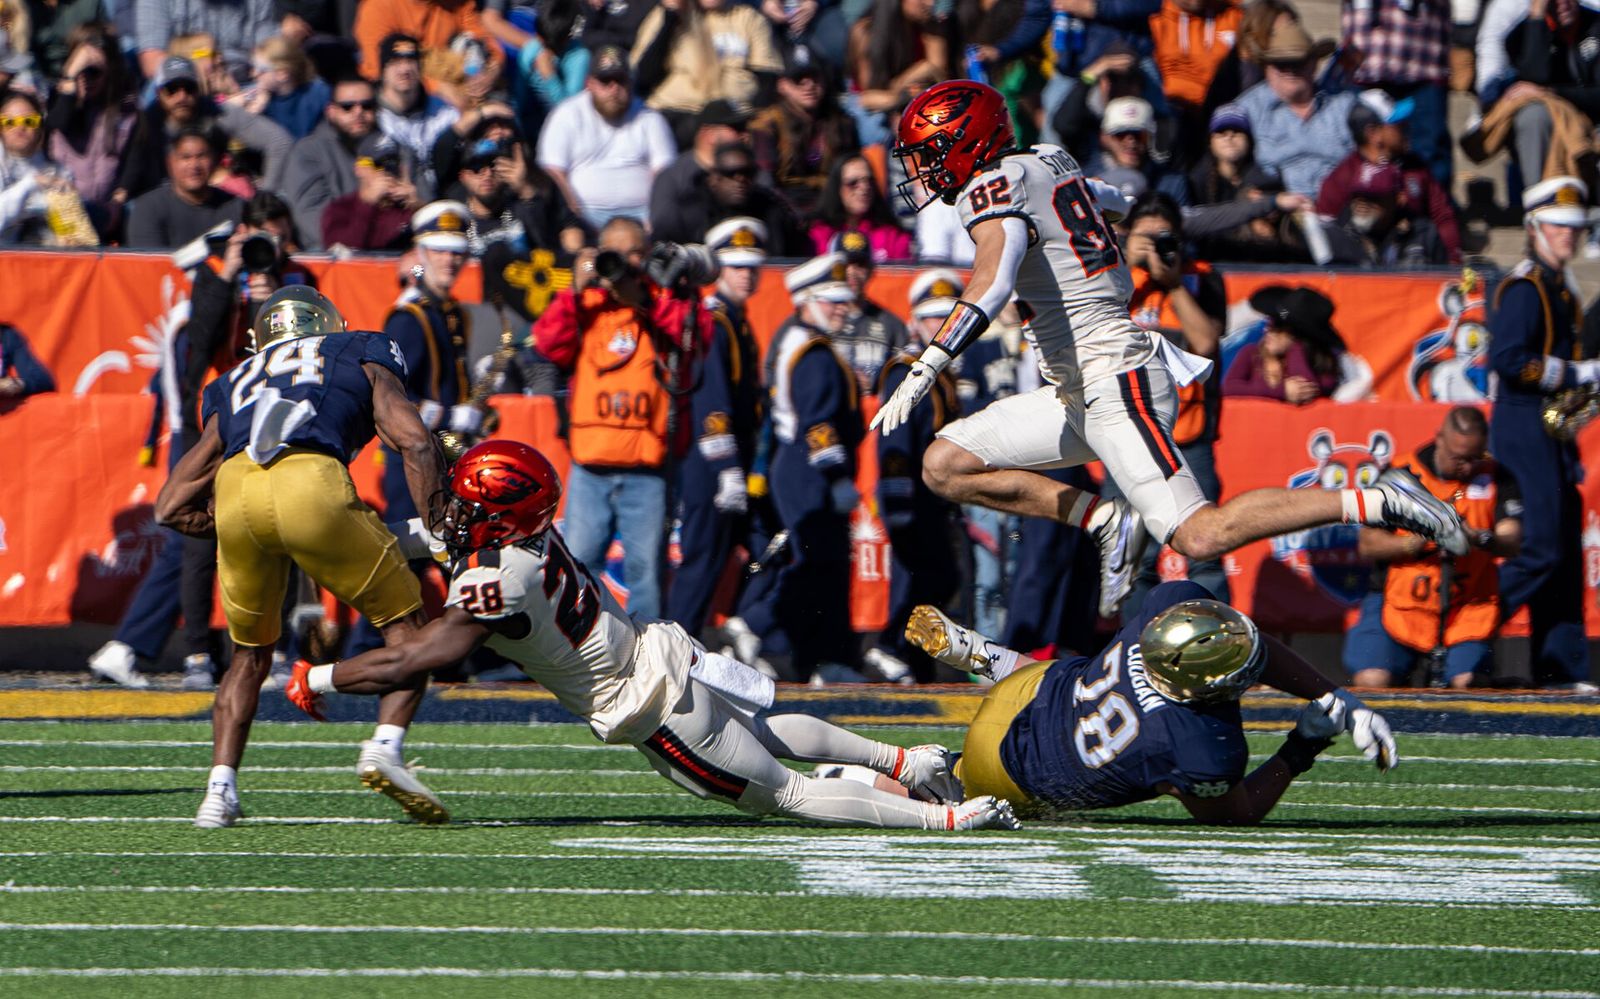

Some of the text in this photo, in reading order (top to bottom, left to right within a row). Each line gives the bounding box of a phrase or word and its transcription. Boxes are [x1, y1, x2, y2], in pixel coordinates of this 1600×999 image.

[969, 175, 1012, 215] 82
[229, 335, 328, 416] 24
[597, 390, 652, 419] 060
[460, 579, 505, 615] 28
[1073, 640, 1141, 770] 78
